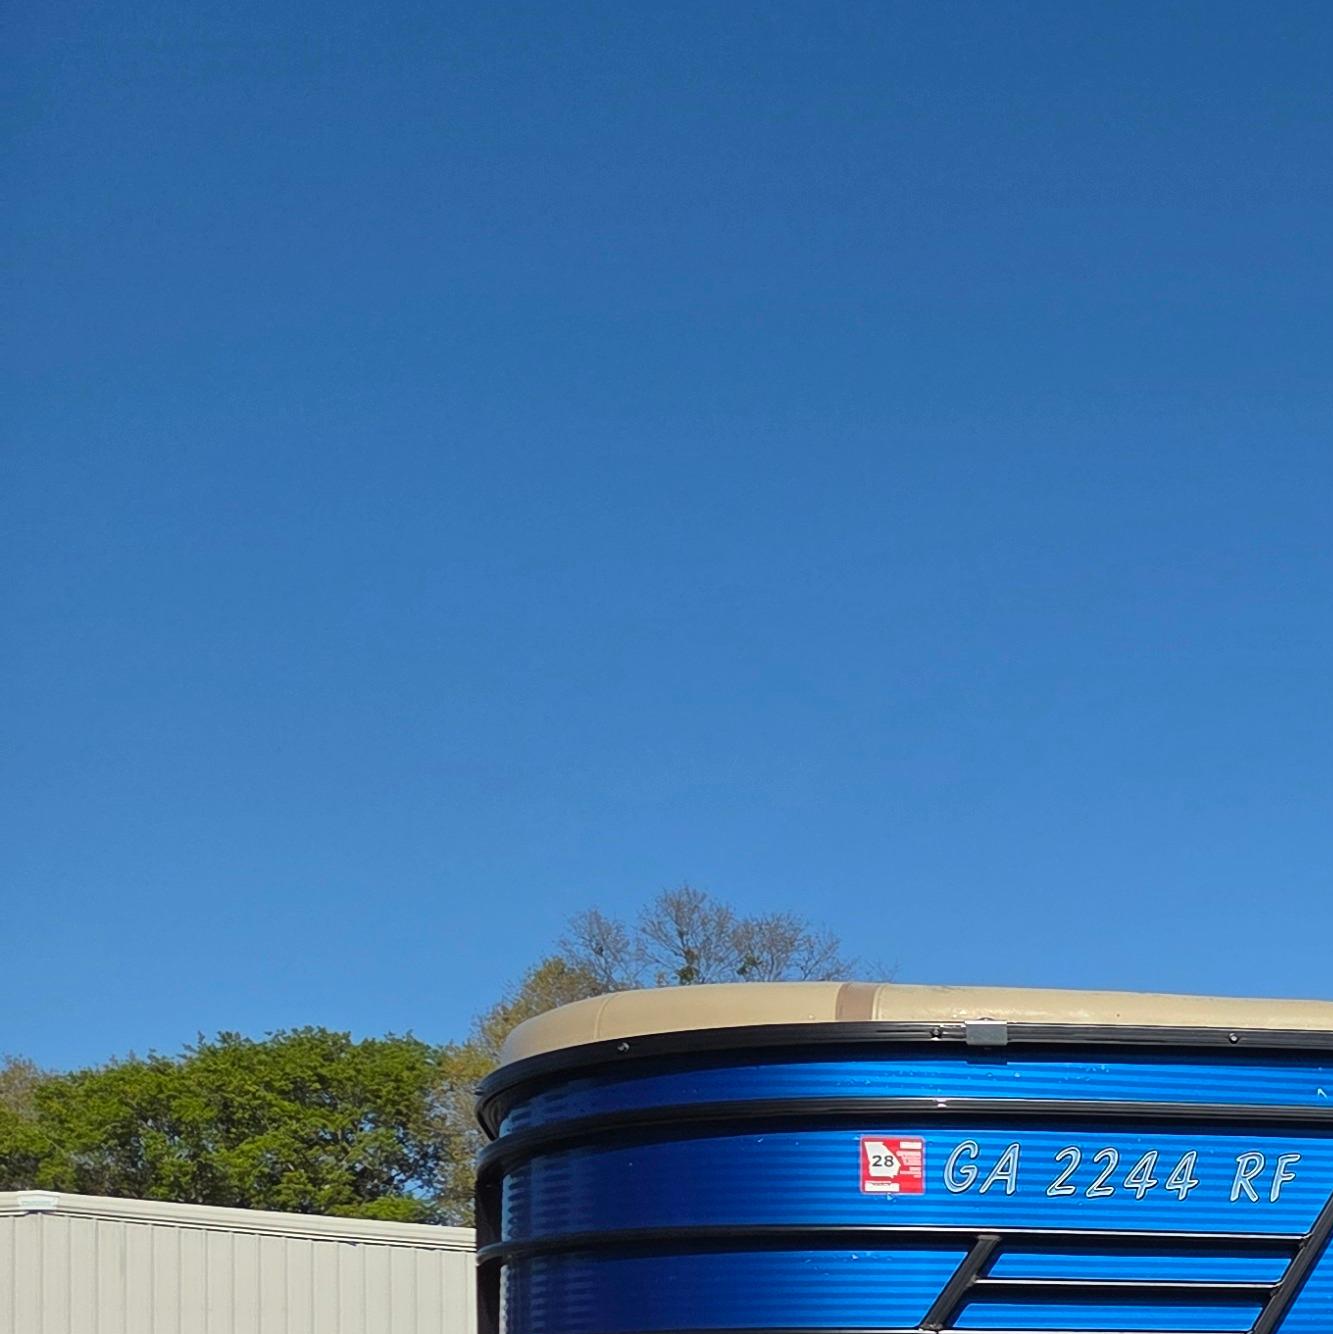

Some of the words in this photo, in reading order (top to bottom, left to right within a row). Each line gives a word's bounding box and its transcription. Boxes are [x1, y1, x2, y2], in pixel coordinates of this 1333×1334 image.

[872, 1155, 894, 1167] 28
[943, 1139, 1021, 1196] GA
[1047, 1146, 1199, 1201] 2244
[1230, 1151, 1302, 1203] RF
